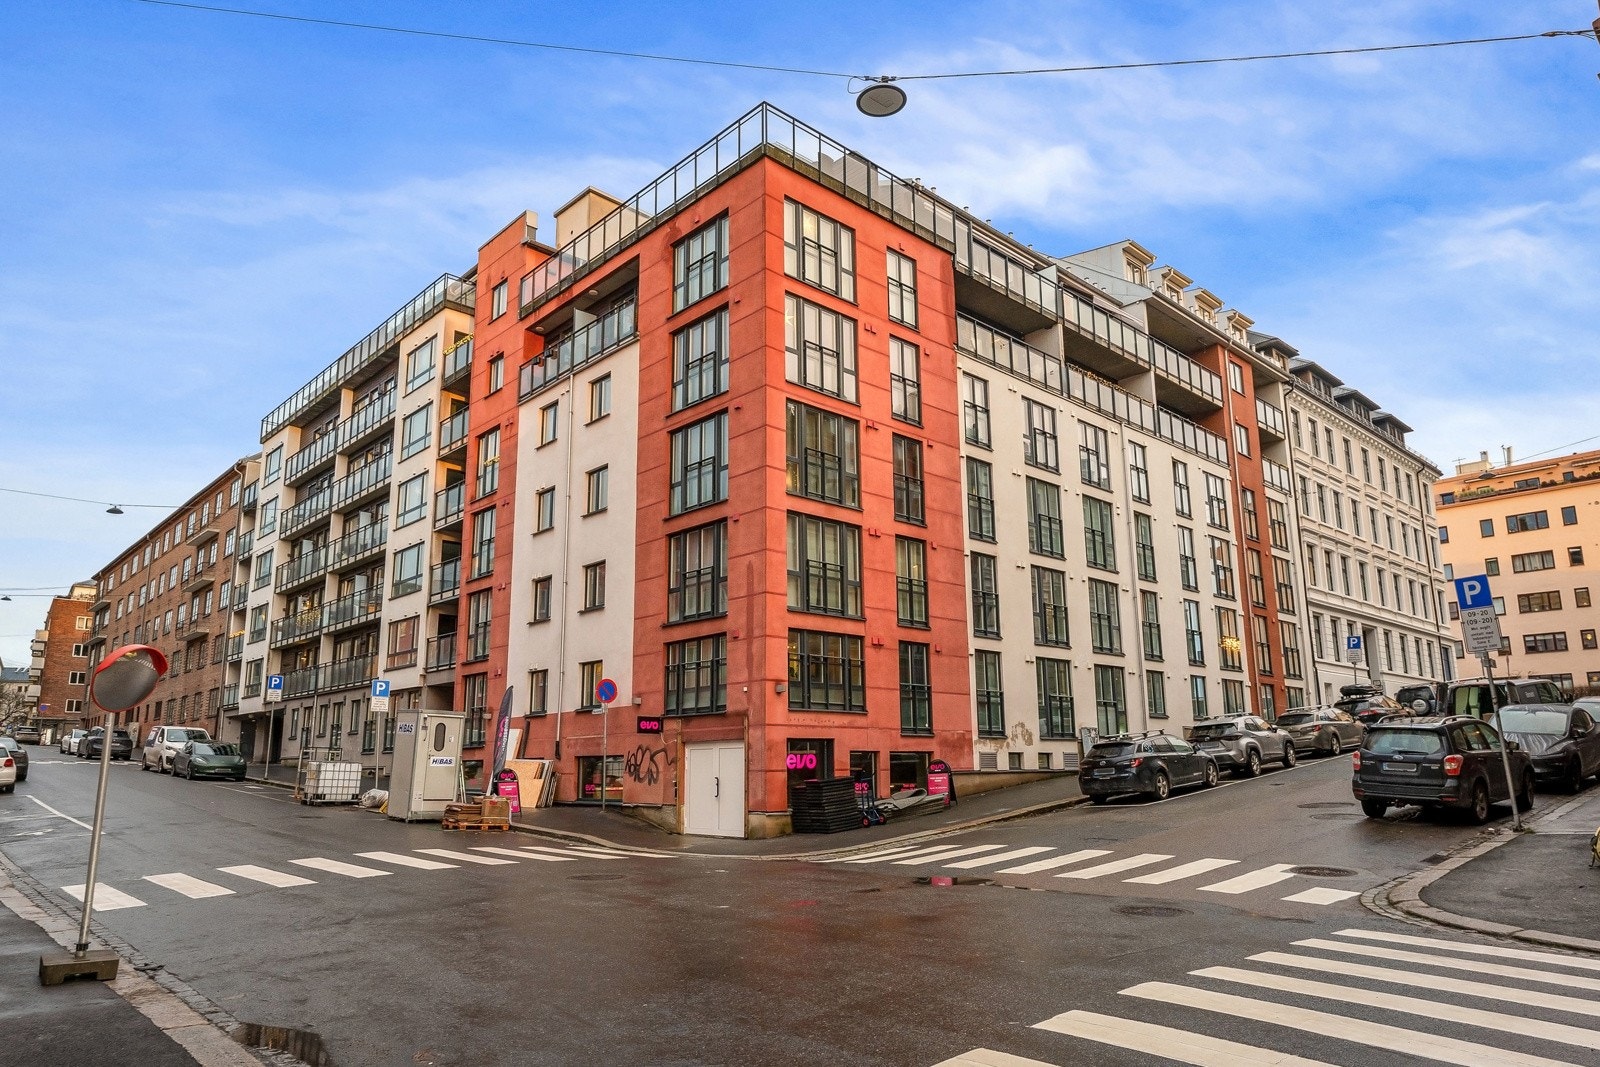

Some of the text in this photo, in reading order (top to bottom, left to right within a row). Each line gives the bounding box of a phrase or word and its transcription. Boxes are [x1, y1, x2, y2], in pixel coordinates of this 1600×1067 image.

[1463, 580, 1481, 605] P
[1350, 637, 1358, 648] P
[271, 677, 280, 688] P
[376, 682, 386, 695] P
[640, 721, 659, 729] evo
[786, 753, 817, 769] evo
